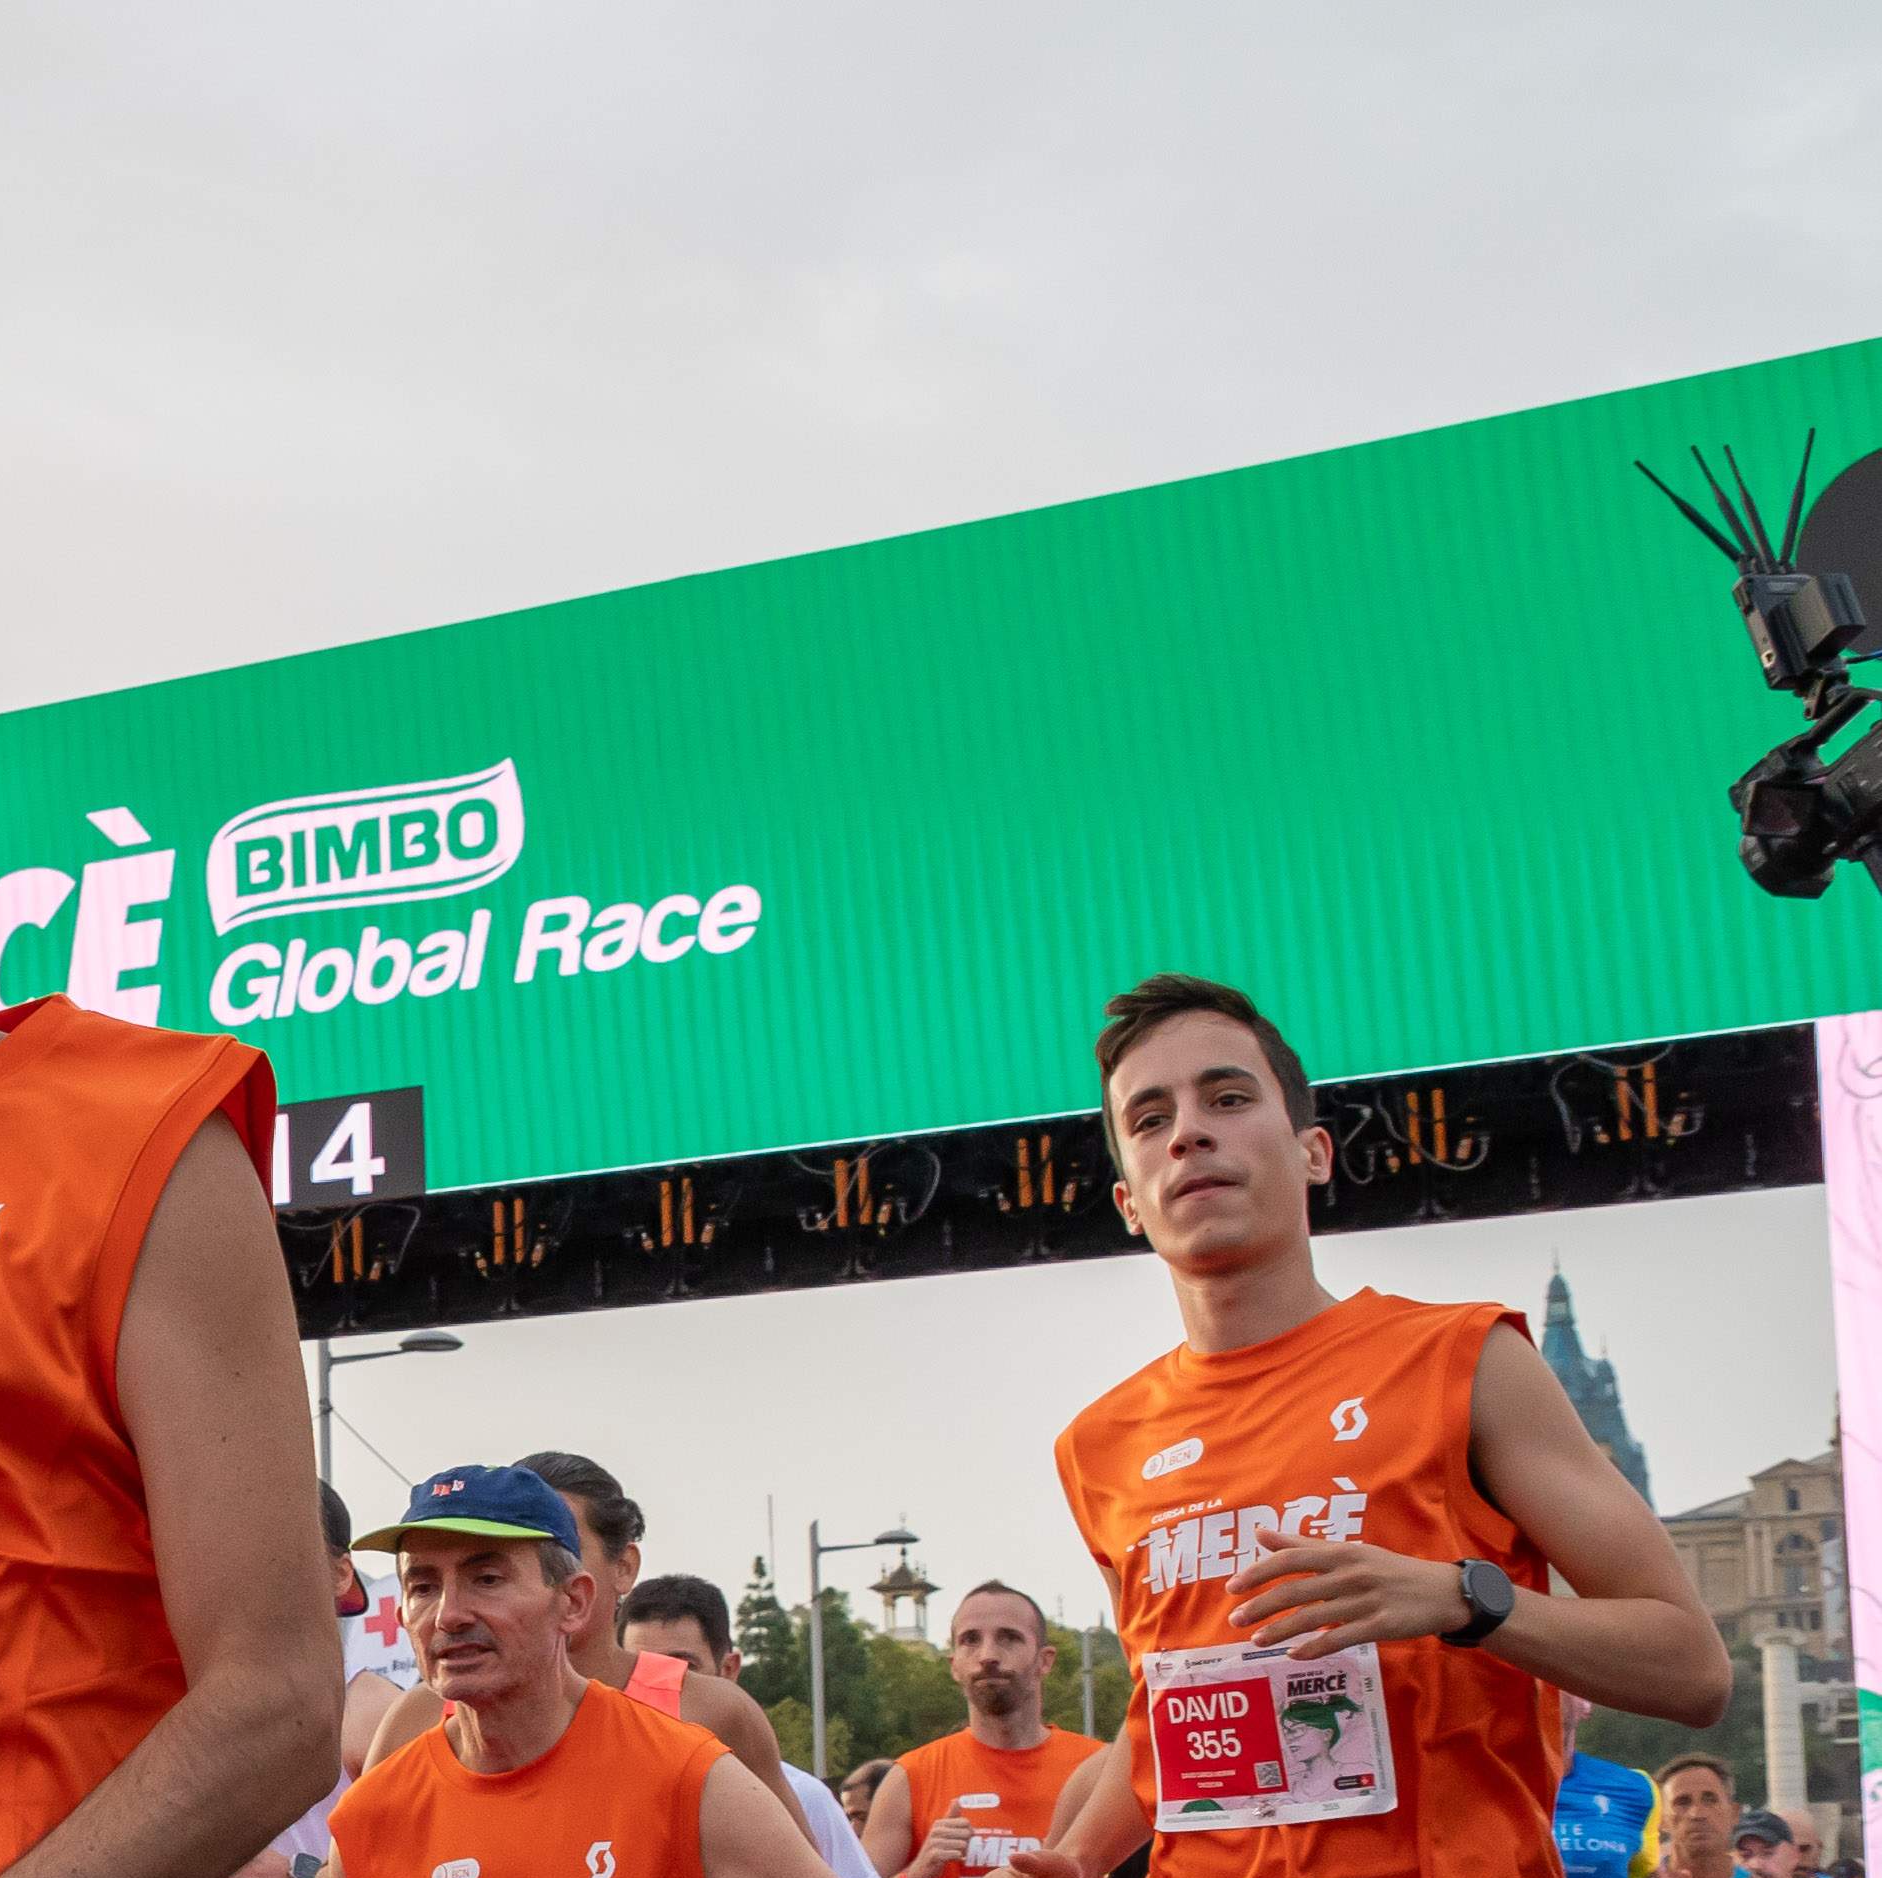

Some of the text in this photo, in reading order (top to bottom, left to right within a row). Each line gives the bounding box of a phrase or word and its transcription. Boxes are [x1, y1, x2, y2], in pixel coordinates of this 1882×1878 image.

[235, 798, 499, 899] BIMBO
[209, 885, 762, 1027] Global Race
[1188, 1501, 1205, 1514] DE
[1207, 1498, 1223, 1508] LA
[1287, 1670, 1347, 1698] MERCÈ
[1167, 1690, 1249, 1724] DAVID
[1186, 1728, 1242, 1760] 355
